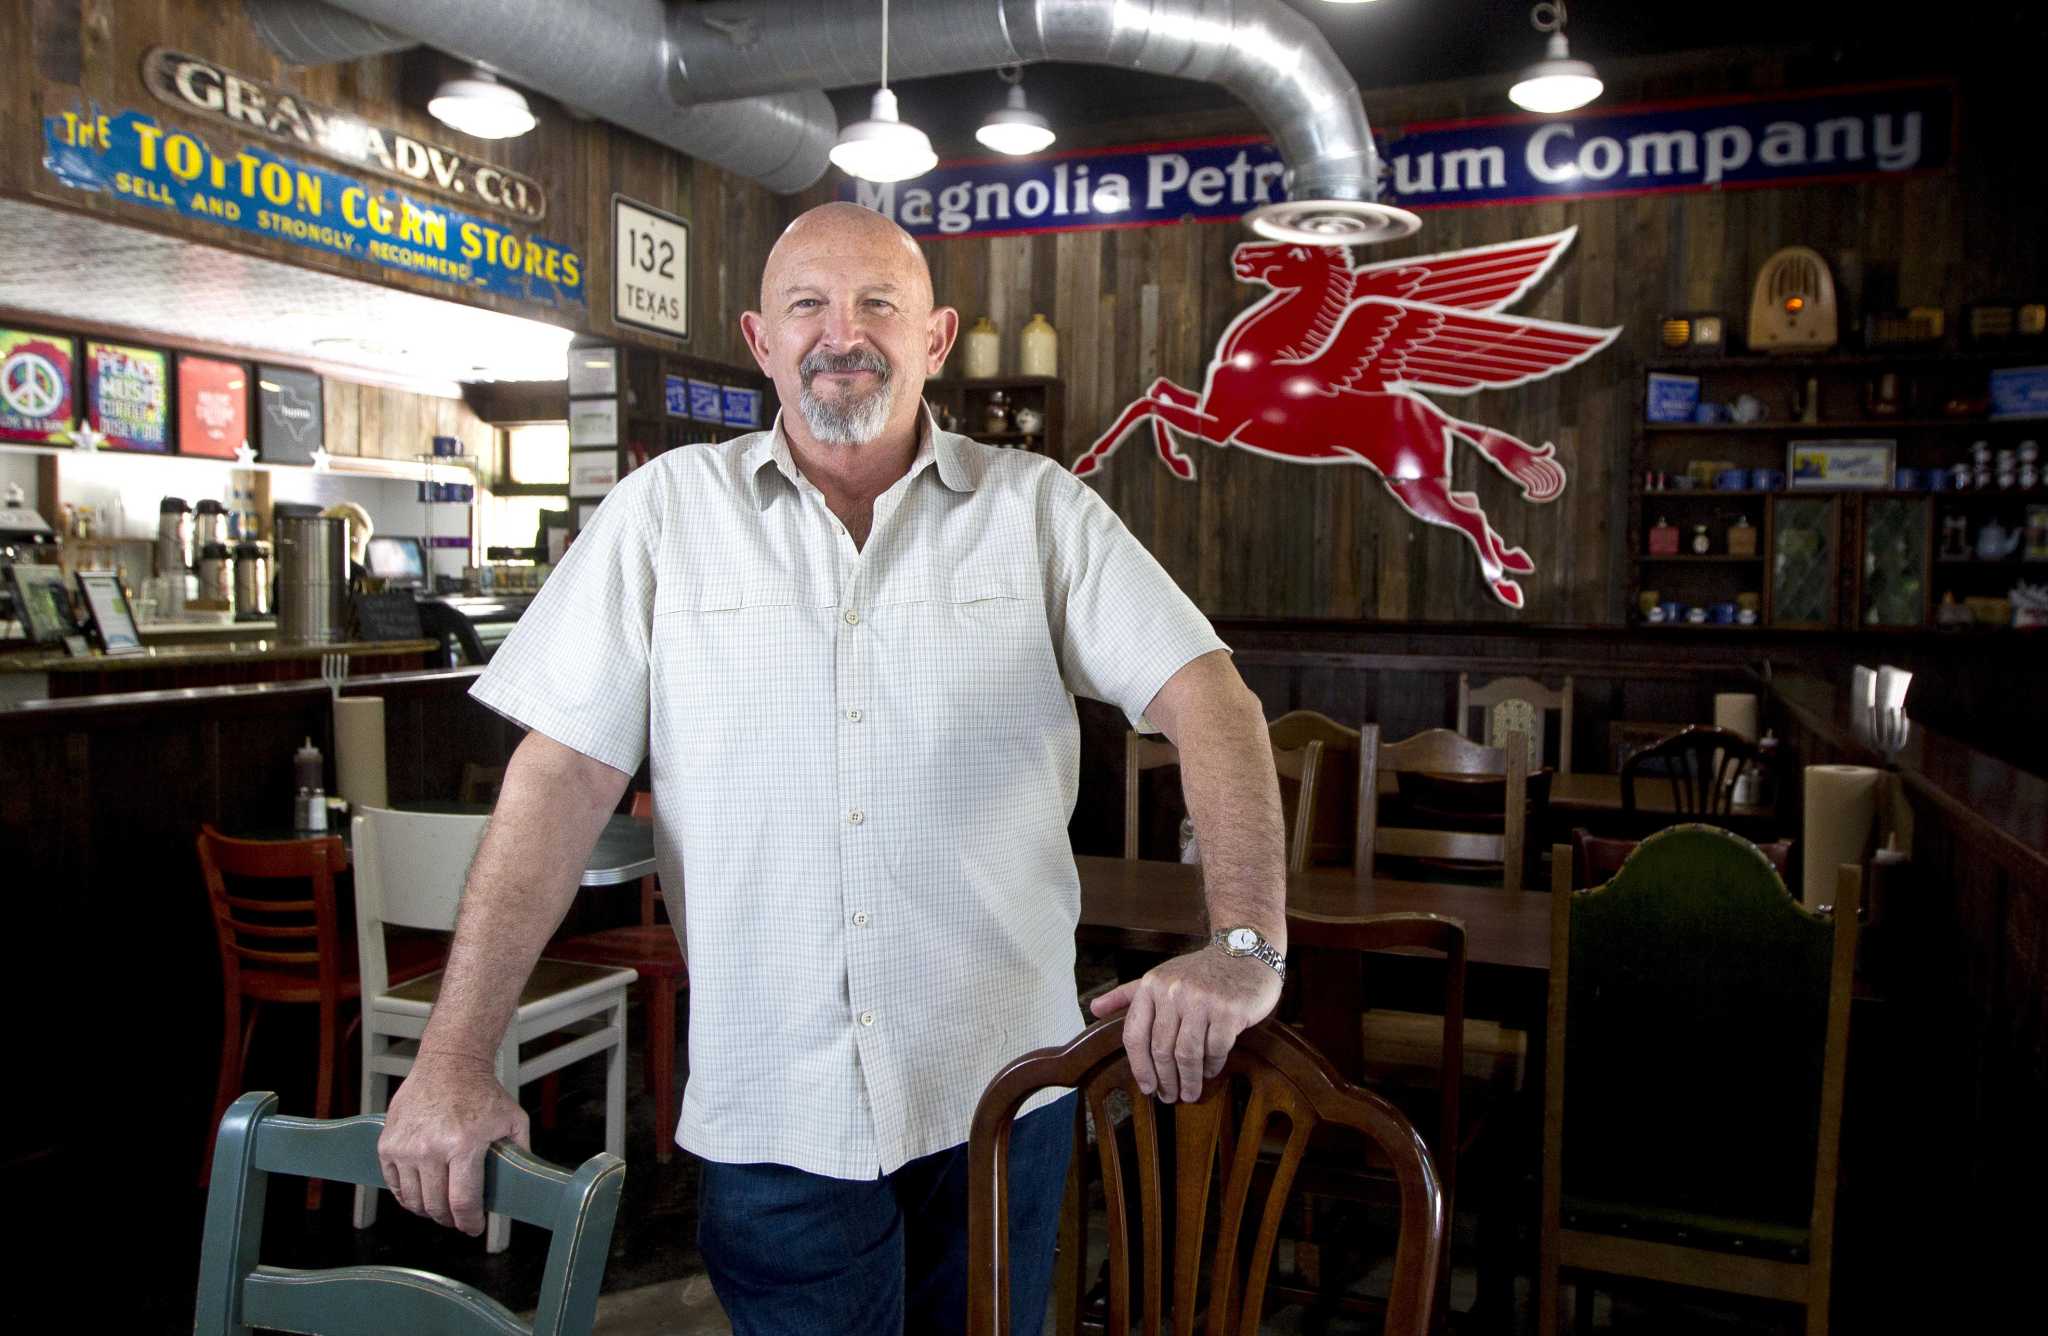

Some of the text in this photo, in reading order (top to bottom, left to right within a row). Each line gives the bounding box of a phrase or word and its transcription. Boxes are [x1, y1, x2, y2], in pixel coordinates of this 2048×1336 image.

[359, 126, 465, 193] ADV.
[855, 110, 1922, 232] Magnolia Petrum Company
[62, 111, 112, 149] THE
[460, 222, 580, 287] STORES
[114, 171, 175, 206] SELL
[191, 192, 241, 222] AND
[629, 228, 675, 280] 132
[626, 283, 679, 321] TEXAS
